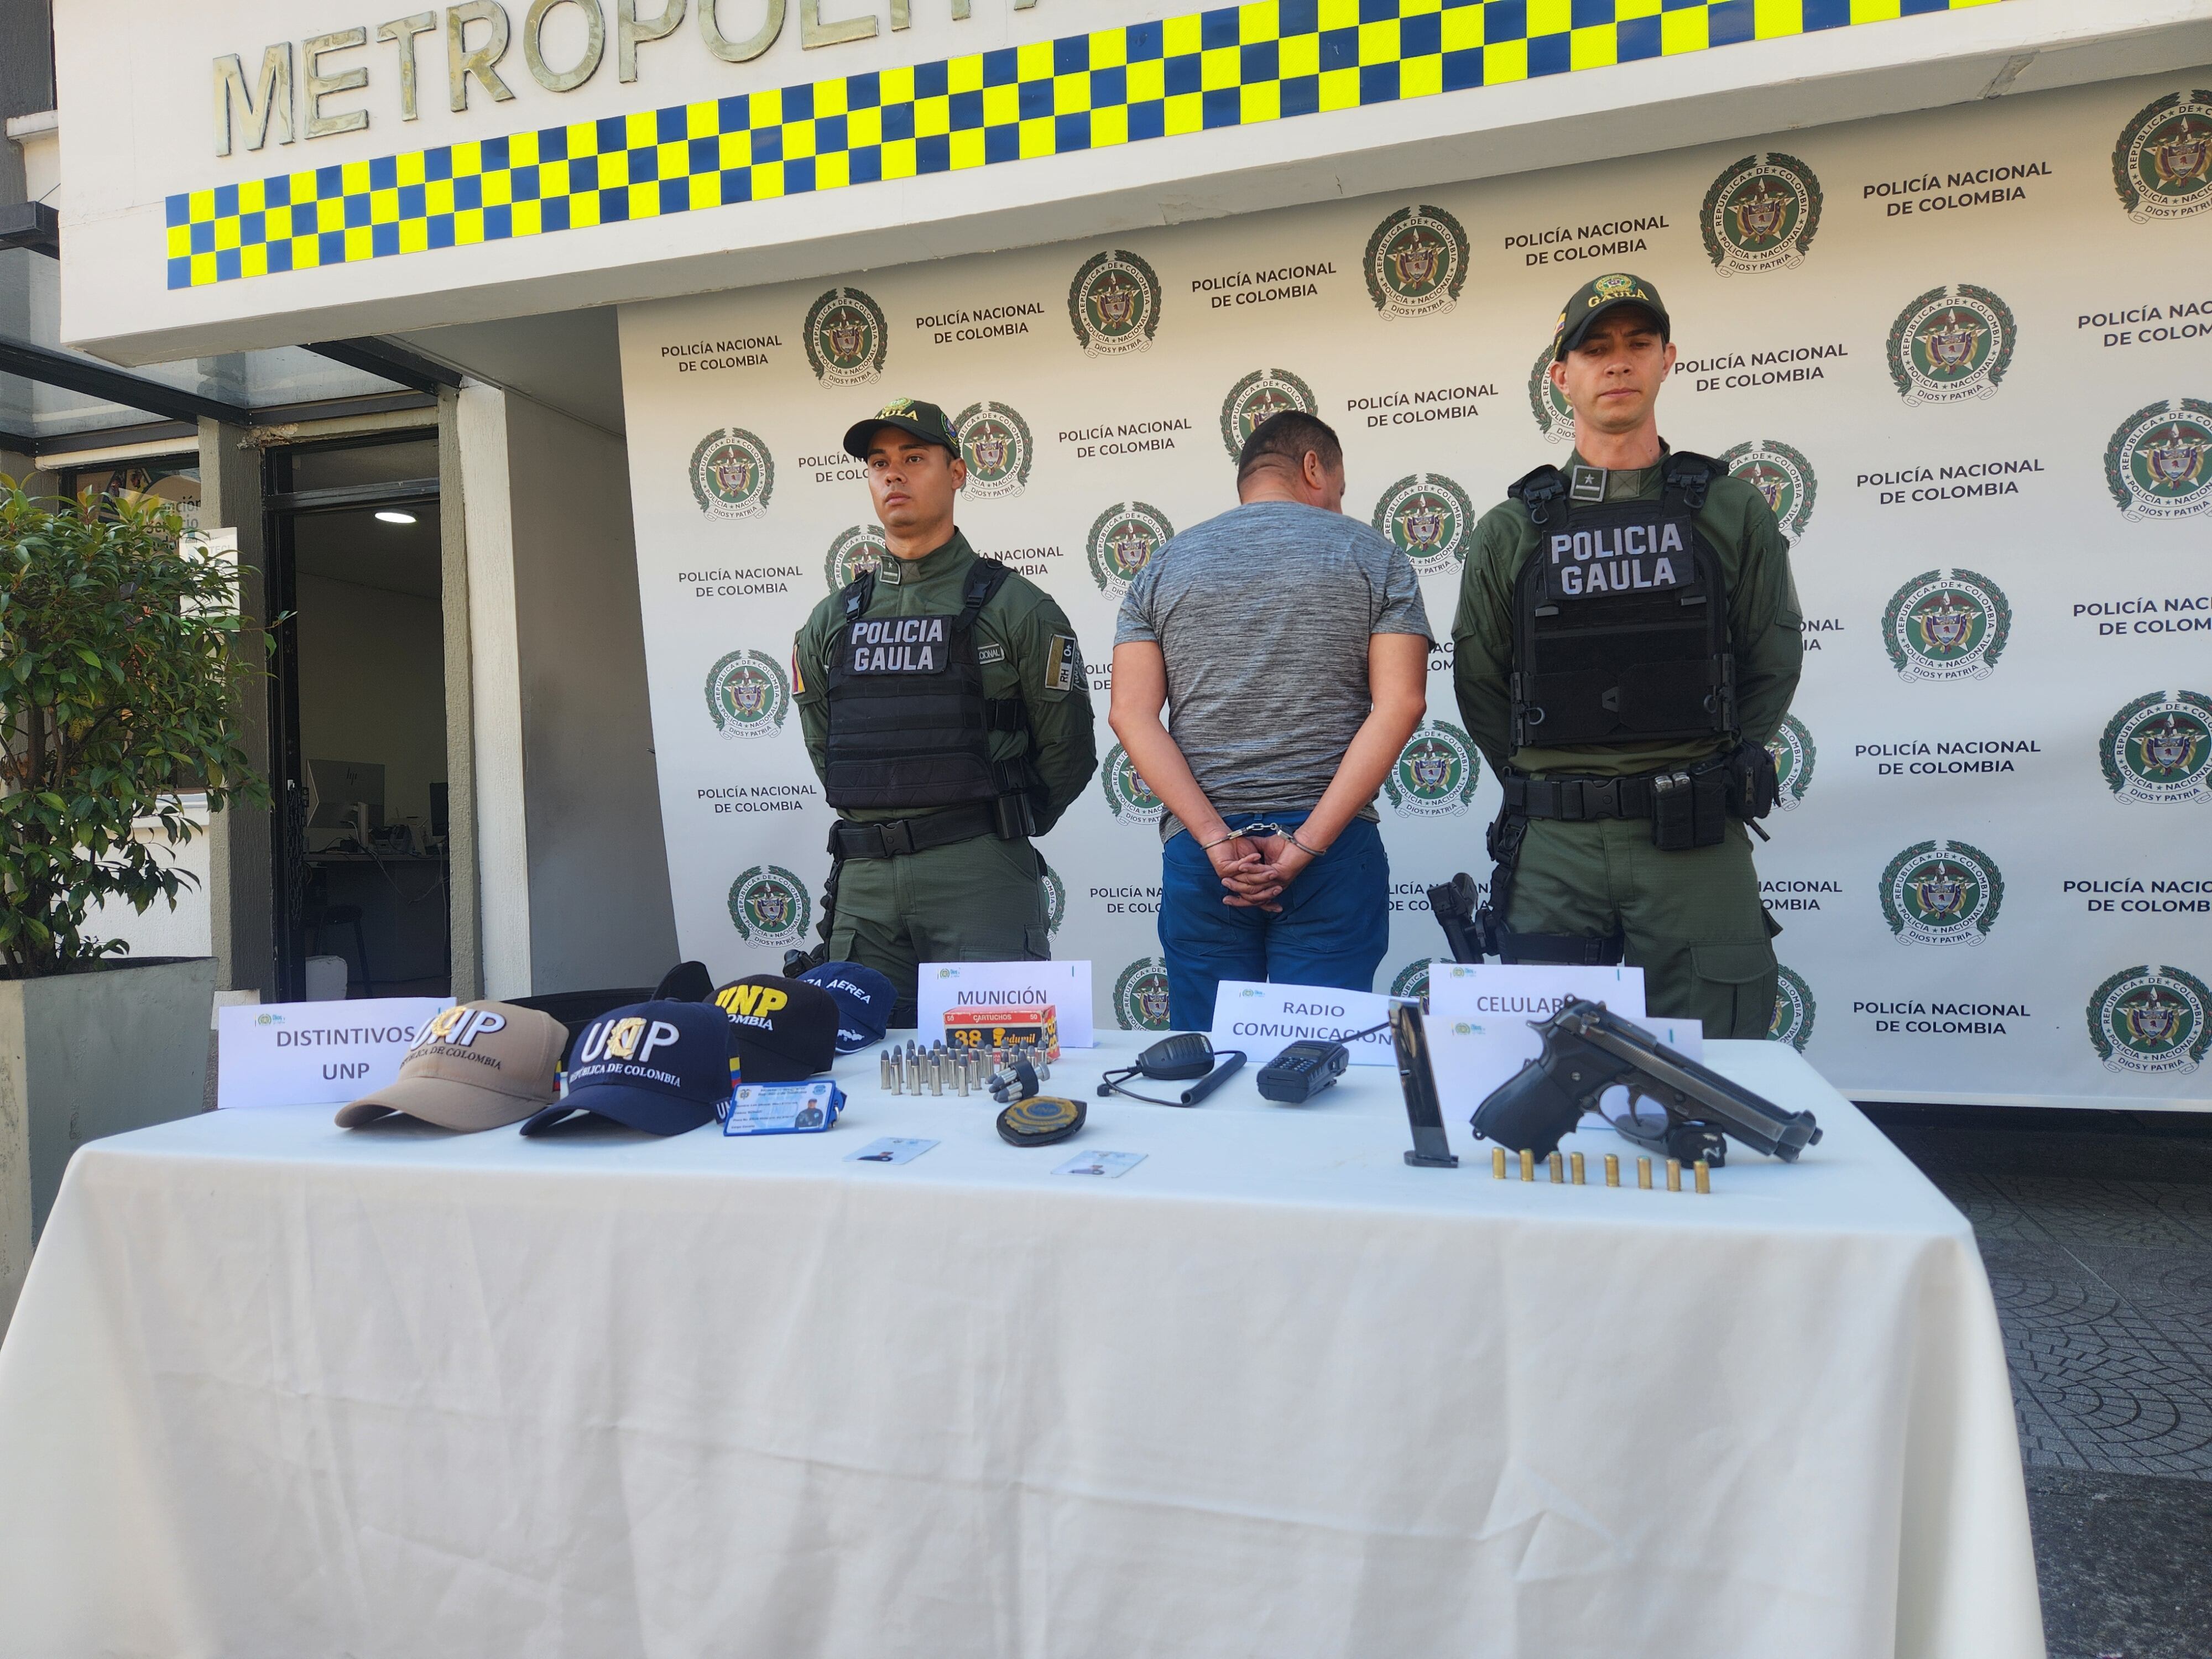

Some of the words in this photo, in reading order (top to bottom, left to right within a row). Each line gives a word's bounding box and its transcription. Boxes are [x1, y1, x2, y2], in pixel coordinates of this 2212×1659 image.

[1864, 174, 1941, 199] POLICÍA
[1948, 162, 2052, 187] NACIONAL
[1779, 170, 1807, 215] COLOMBIA
[1887, 201, 1912, 216] DE
[1919, 186, 2026, 212] COLOMBIA
[1505, 227, 1572, 249] POLICÍA
[1578, 216, 1669, 239] NACIONAL
[1761, 226, 1803, 258] NACIONAL
[1526, 252, 1548, 266] DE
[1554, 239, 1647, 262] COLOMBIA
[1729, 260, 1750, 270] DIOS
[1760, 254, 1792, 270] PATRIA
[1192, 272, 1251, 292] POLICÍA
[1256, 262, 1336, 284] NACIONAL
[1212, 295, 1231, 308] DE
[1236, 284, 1318, 304] COLOMBIA
[1588, 288, 1650, 308] GAULA
[854, 302, 878, 340] COLOMBIA
[916, 310, 969, 328] POLICÍA
[973, 302, 1044, 321] NACIONAL
[2079, 305, 2162, 328] POLICÍA
[935, 332, 952, 344] DE
[956, 322, 1029, 341] COLOMBIA
[2104, 332, 2131, 347] DE
[661, 341, 713, 357] POLICÍA
[717, 335, 782, 352] NACIONAL
[679, 361, 697, 372] DE
[701, 354, 768, 370] COLOMBIA
[849, 349, 877, 374] NACIONAL
[1674, 352, 1746, 375] POLICÍA
[1752, 344, 1848, 366] NACIONAL
[829, 375, 843, 384] DIOS
[851, 371, 872, 384] PATRIA
[1697, 378, 1720, 392] DE
[1726, 367, 1824, 388] COLOMBIA
[1348, 392, 1410, 411] POLICÍA
[1415, 384, 1498, 404] NACIONAL
[1368, 415, 1387, 427] DE
[1393, 405, 1478, 424] COLOMBIA
[1060, 425, 1114, 442] POLICÍA
[1118, 419, 1192, 436] NACIONAL
[1077, 446, 1095, 458] DE
[1100, 438, 1175, 455] COLOMBIA
[799, 452, 849, 467] POLICÍA
[816, 472, 833, 482] DE
[1858, 466, 1933, 487] POLICÍA
[1940, 459, 2044, 479] NACIONAL
[1881, 491, 1905, 504] DE
[1912, 482, 2018, 502] COLOMBIA
[994, 546, 1064, 561] NACIONAL
[1551, 523, 1684, 564] POLICIA
[679, 568, 731, 582] POLICÍA
[735, 566, 802, 579] NACIONAL
[1561, 557, 1677, 596] GAULA
[696, 587, 713, 597] DE
[718, 583, 787, 596] COLOMBIA
[2074, 597, 2157, 617] POLICÍA
[851, 619, 943, 644] POLICIA
[2100, 622, 2127, 635] DE
[854, 646, 933, 671] GAULA
[1063, 644, 1072, 657] O+
[1060, 669, 1070, 683] RH
[1856, 740, 1931, 757] POLICÍA
[1938, 740, 2041, 754] NACIONAL
[1879, 763, 1903, 775] DE
[1910, 760, 2015, 774] COLOMBIA
[698, 786, 748, 799] POLICÍA
[751, 785, 817, 796] NACIONAL
[714, 804, 732, 813] DE
[735, 801, 803, 812] COLOMBIA
[779, 878, 802, 910] COLOMBIA
[1090, 885, 1142, 898] POLICÍA
[2064, 878, 2145, 893] POLICÍA
[1107, 904, 1125, 913] DE
[2088, 900, 2115, 911] DE
[775, 916, 800, 938] NACIONAL
[754, 937, 769, 946] DIOS
[776, 936, 796, 946] PATRIA
[826, 979, 872, 1004] AEREA
[957, 987, 1047, 1005] MUNICIÓN
[1283, 1002, 1345, 1018] RADIO
[1854, 1000, 1926, 1014] POLICÍA
[1932, 1004, 2031, 1016] NACIONAL
[2173, 983, 2203, 1026] COLOMBIA
[276, 1026, 414, 1047] DISTINTIVOS
[1876, 1021, 1900, 1032] DE
[1906, 1021, 2006, 1034] COLOMBIA
[954, 1030, 982, 1048] 38
[2152, 1035, 2197, 1060] NACIONAL
[446, 1047, 501, 1070] COLOMBIA
[2118, 1057, 2141, 1069] DIOS
[2151, 1059, 2184, 1071] PATRIA
[322, 1062, 370, 1080] UNP
[607, 1063, 623, 1074] DE
[624, 1065, 681, 1087] COLOMBIA
